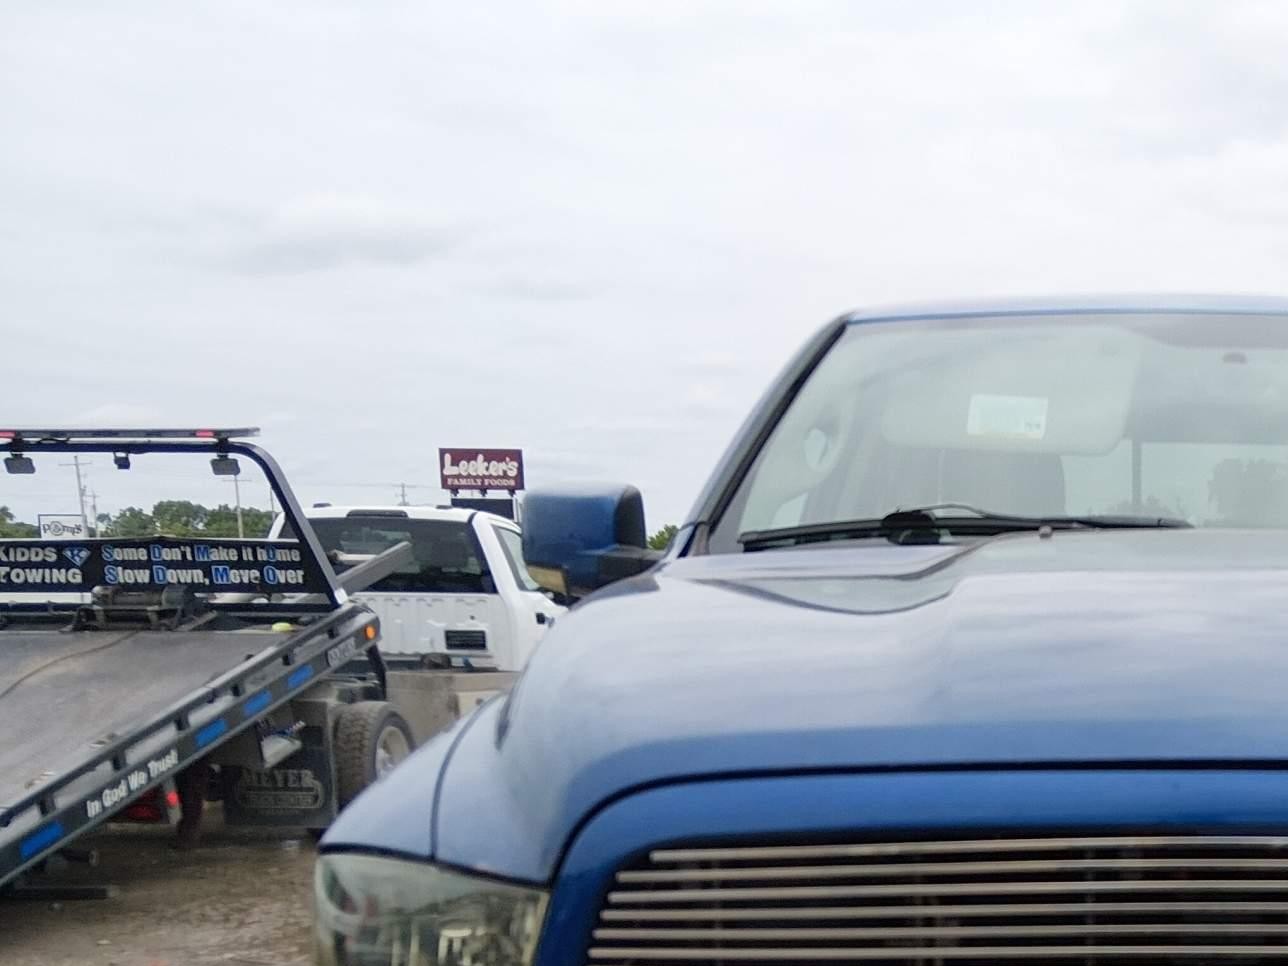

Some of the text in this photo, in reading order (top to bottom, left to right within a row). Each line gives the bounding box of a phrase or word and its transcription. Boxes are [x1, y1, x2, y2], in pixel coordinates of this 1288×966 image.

[443, 453, 518, 477] Leeker's
[447, 478, 515, 487] FAMILY FOODS
[101, 544, 147, 561] Some
[150, 544, 192, 561] Don't
[194, 545, 238, 561] Make
[242, 546, 253, 561] it
[104, 565, 304, 585] Slow Down, Move Over
[87, 750, 178, 817] In God We Trust
